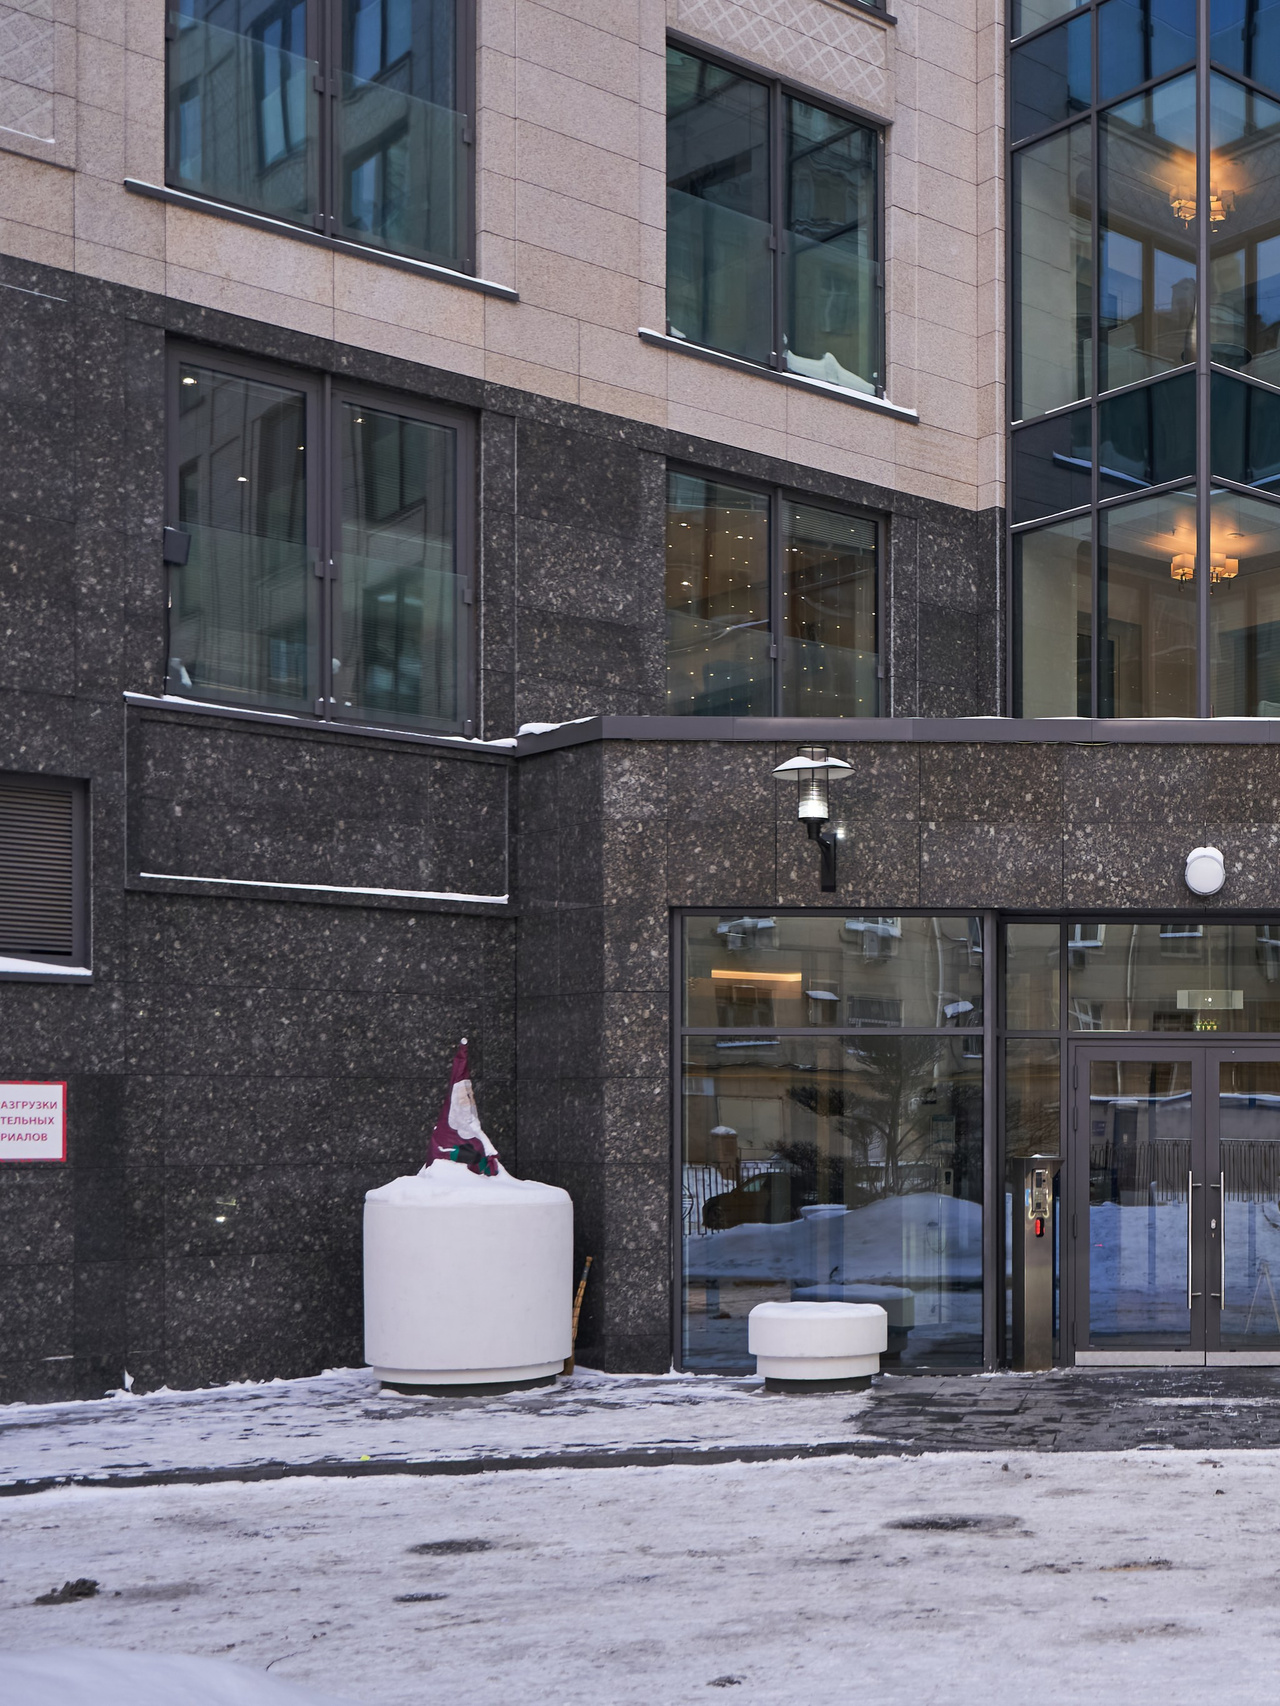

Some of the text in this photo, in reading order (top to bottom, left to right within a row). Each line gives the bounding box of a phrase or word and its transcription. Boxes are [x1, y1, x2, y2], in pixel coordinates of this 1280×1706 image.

[0, 1101, 58, 1109] АЗГРУЗКИ
[0, 1116, 55, 1125] ТЕЛЬНЫХ
[0, 1133, 48, 1141] РИАЛОВ
